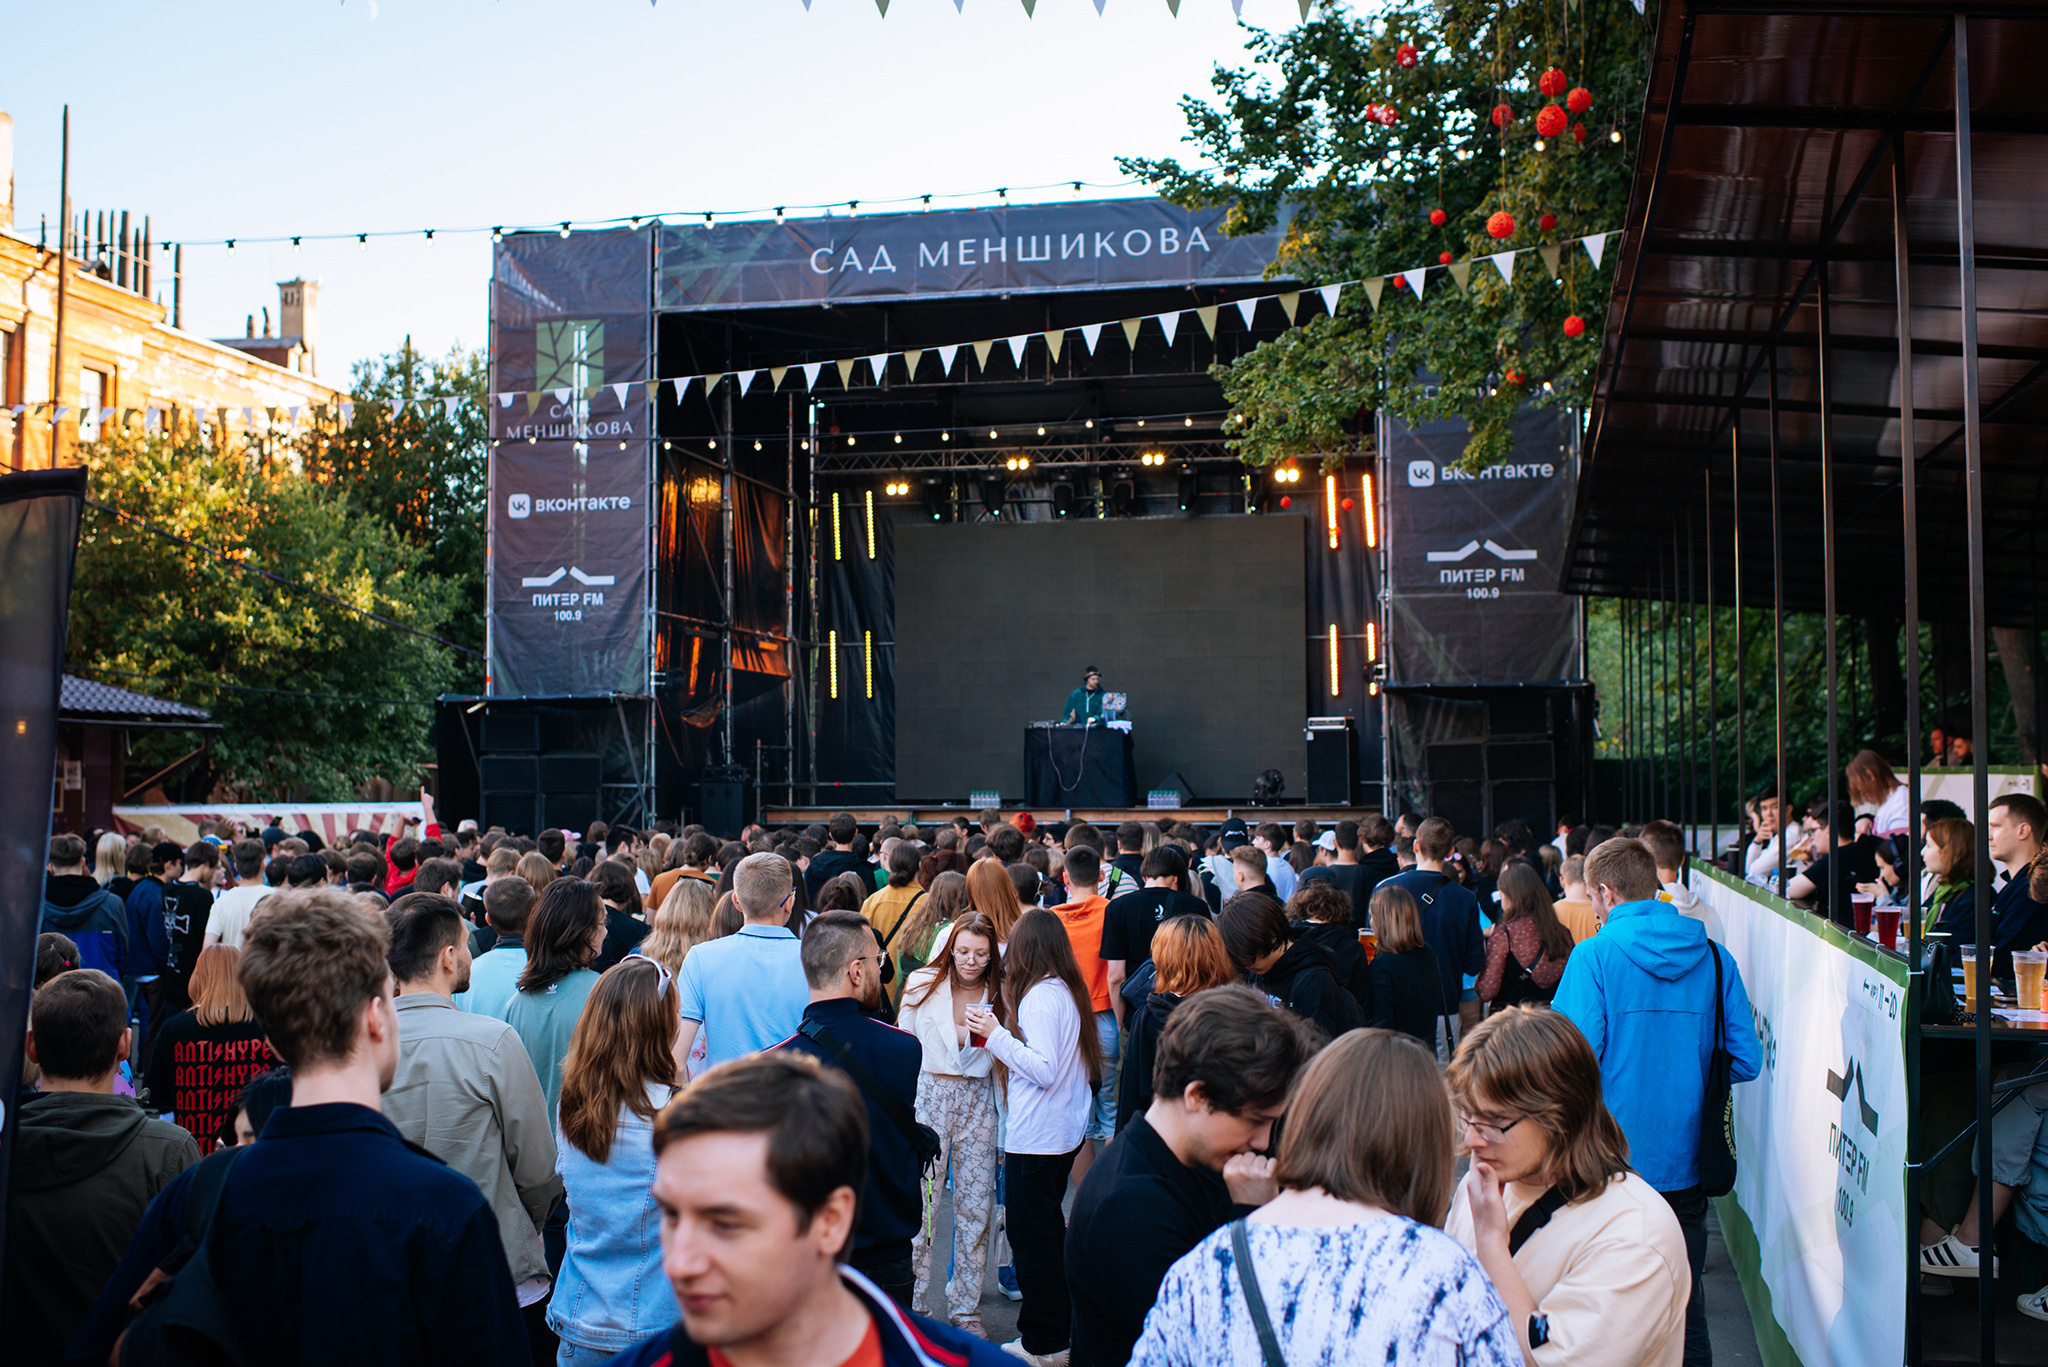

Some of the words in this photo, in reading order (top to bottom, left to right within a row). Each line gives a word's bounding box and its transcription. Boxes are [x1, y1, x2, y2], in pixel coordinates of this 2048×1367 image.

[810, 245, 897, 275] САД
[919, 225, 1211, 268] МЕНШИКОВА
[550, 404, 591, 419] СА
[1440, 568, 1496, 584] ПИТЕР
[1501, 568, 1525, 582] FM
[532, 593, 580, 607] ПИТЕР
[583, 592, 604, 606] FM
[1466, 587, 1500, 599] 100.9
[553, 610, 583, 621] 100.9
[1829, 1121, 1857, 1177] ПИТЕР
[1857, 1151, 1870, 1196] FM
[1838, 1186, 1854, 1228] 100.9
